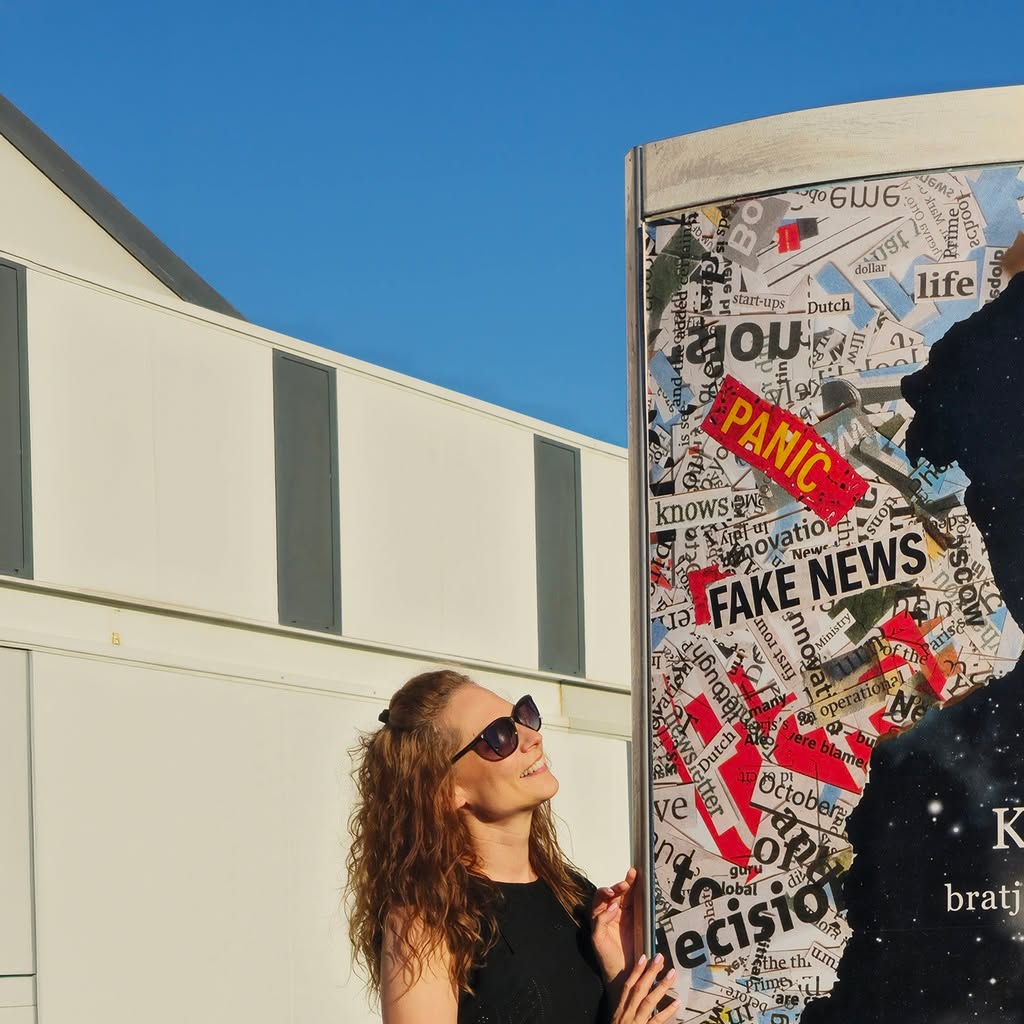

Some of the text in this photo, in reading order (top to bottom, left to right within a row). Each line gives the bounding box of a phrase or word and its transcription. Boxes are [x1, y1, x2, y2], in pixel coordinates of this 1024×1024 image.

[854, 263, 887, 276] dollar
[916, 270, 976, 299] life
[732, 292, 785, 310] start-ups
[807, 298, 850, 315] Dutch
[721, 396, 832, 493] PANIC
[655, 498, 729, 527] knows
[708, 531, 927, 630] FAKE NEWS
[814, 612, 852, 651] Ministry
[882, 643, 902, 657] of
[772, 647, 797, 683] first
[749, 692, 787, 718] many
[819, 670, 905, 718] operational
[698, 729, 737, 774] Dutch
[758, 773, 840, 819] October
[729, 864, 763, 879] guru
[762, 955, 787, 970] the
